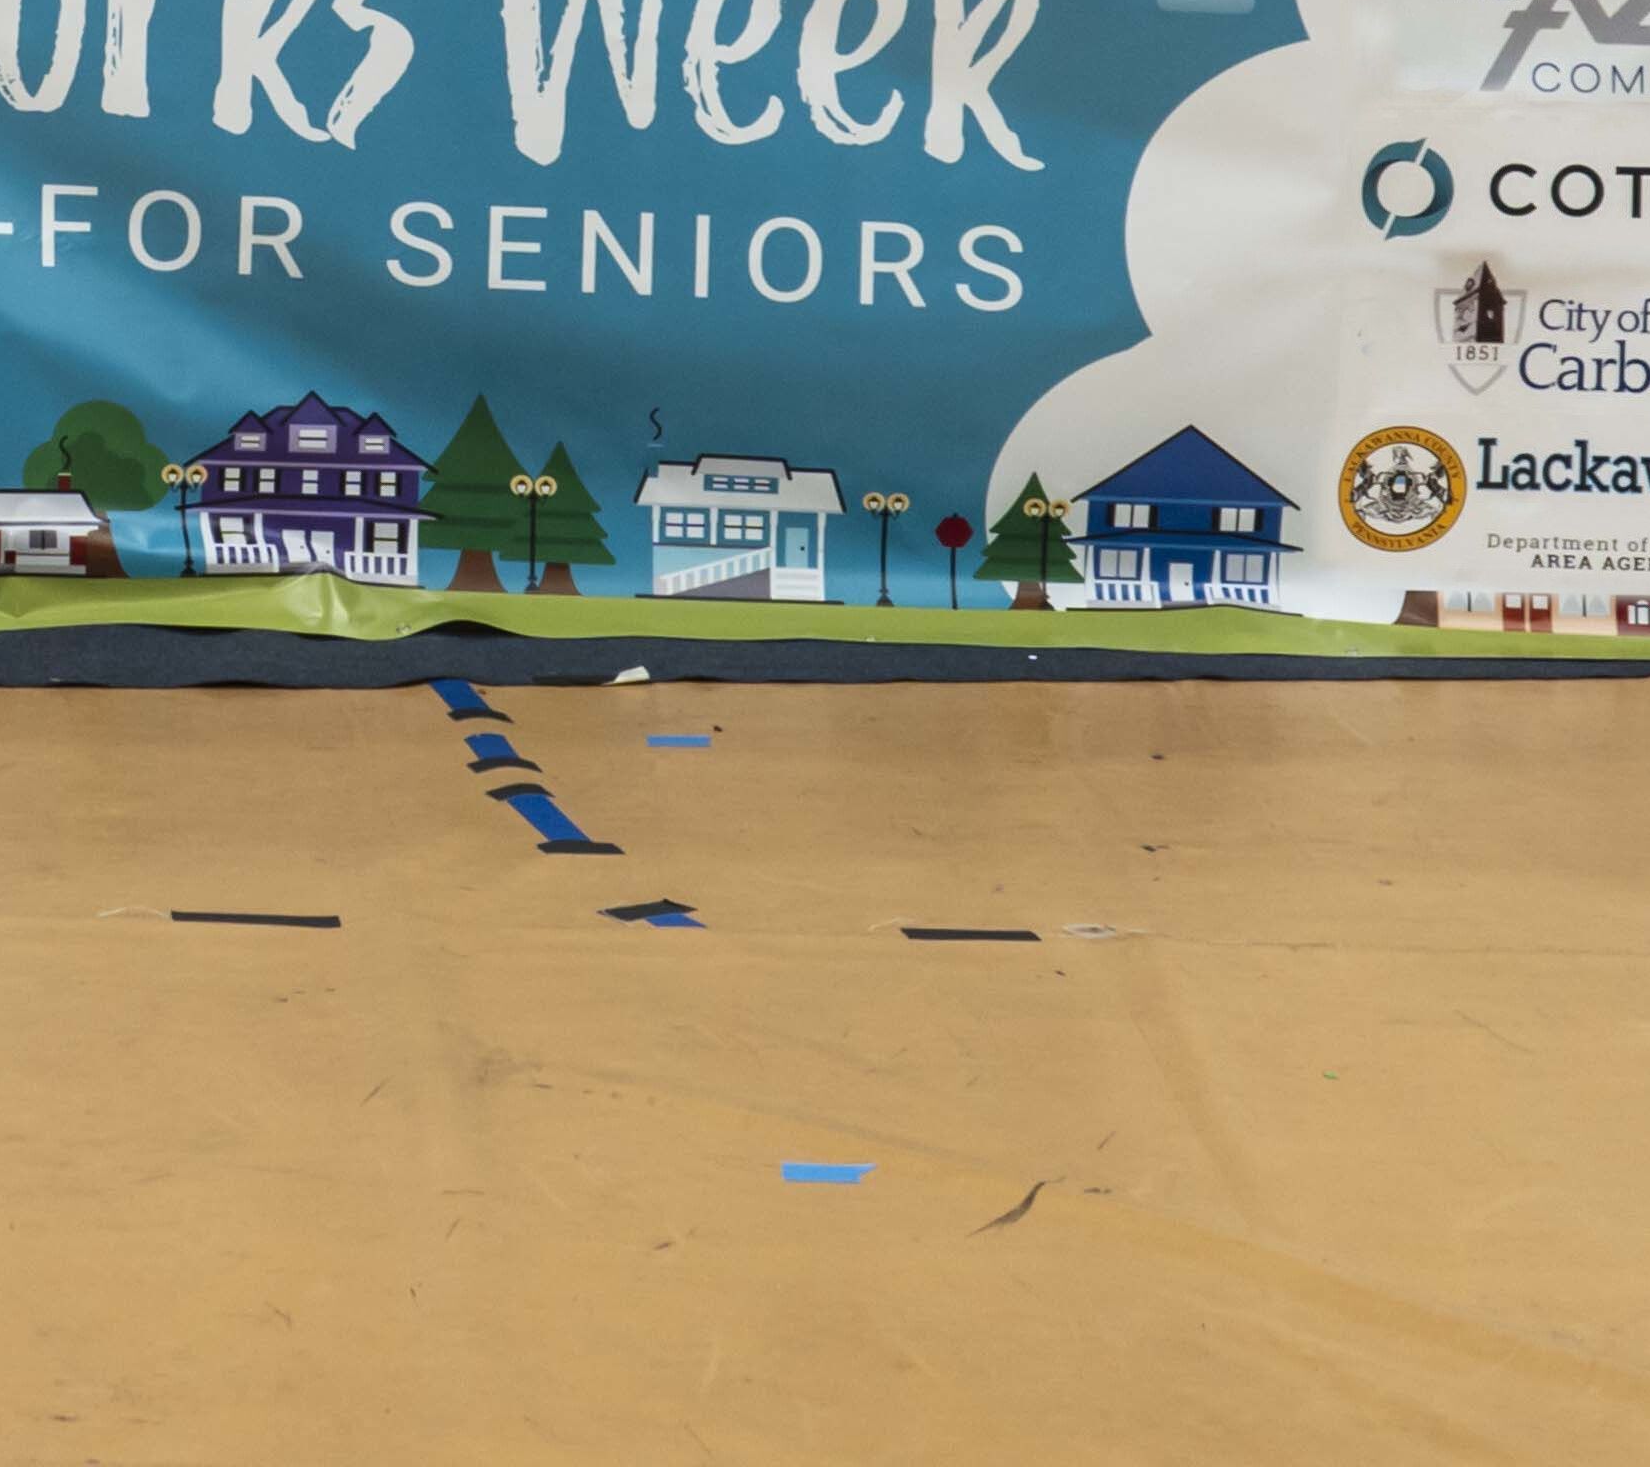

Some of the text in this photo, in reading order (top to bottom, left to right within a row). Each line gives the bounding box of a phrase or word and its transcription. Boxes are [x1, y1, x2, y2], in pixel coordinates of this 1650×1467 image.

[38, 183, 1029, 315] FOR SENIORS
[1538, 298, 1612, 342] City
[1454, 345, 1500, 362] 1851
[1487, 533, 1622, 554] Department
[1627, 536, 1650, 553] of
[1530, 554, 1593, 571] AREA
